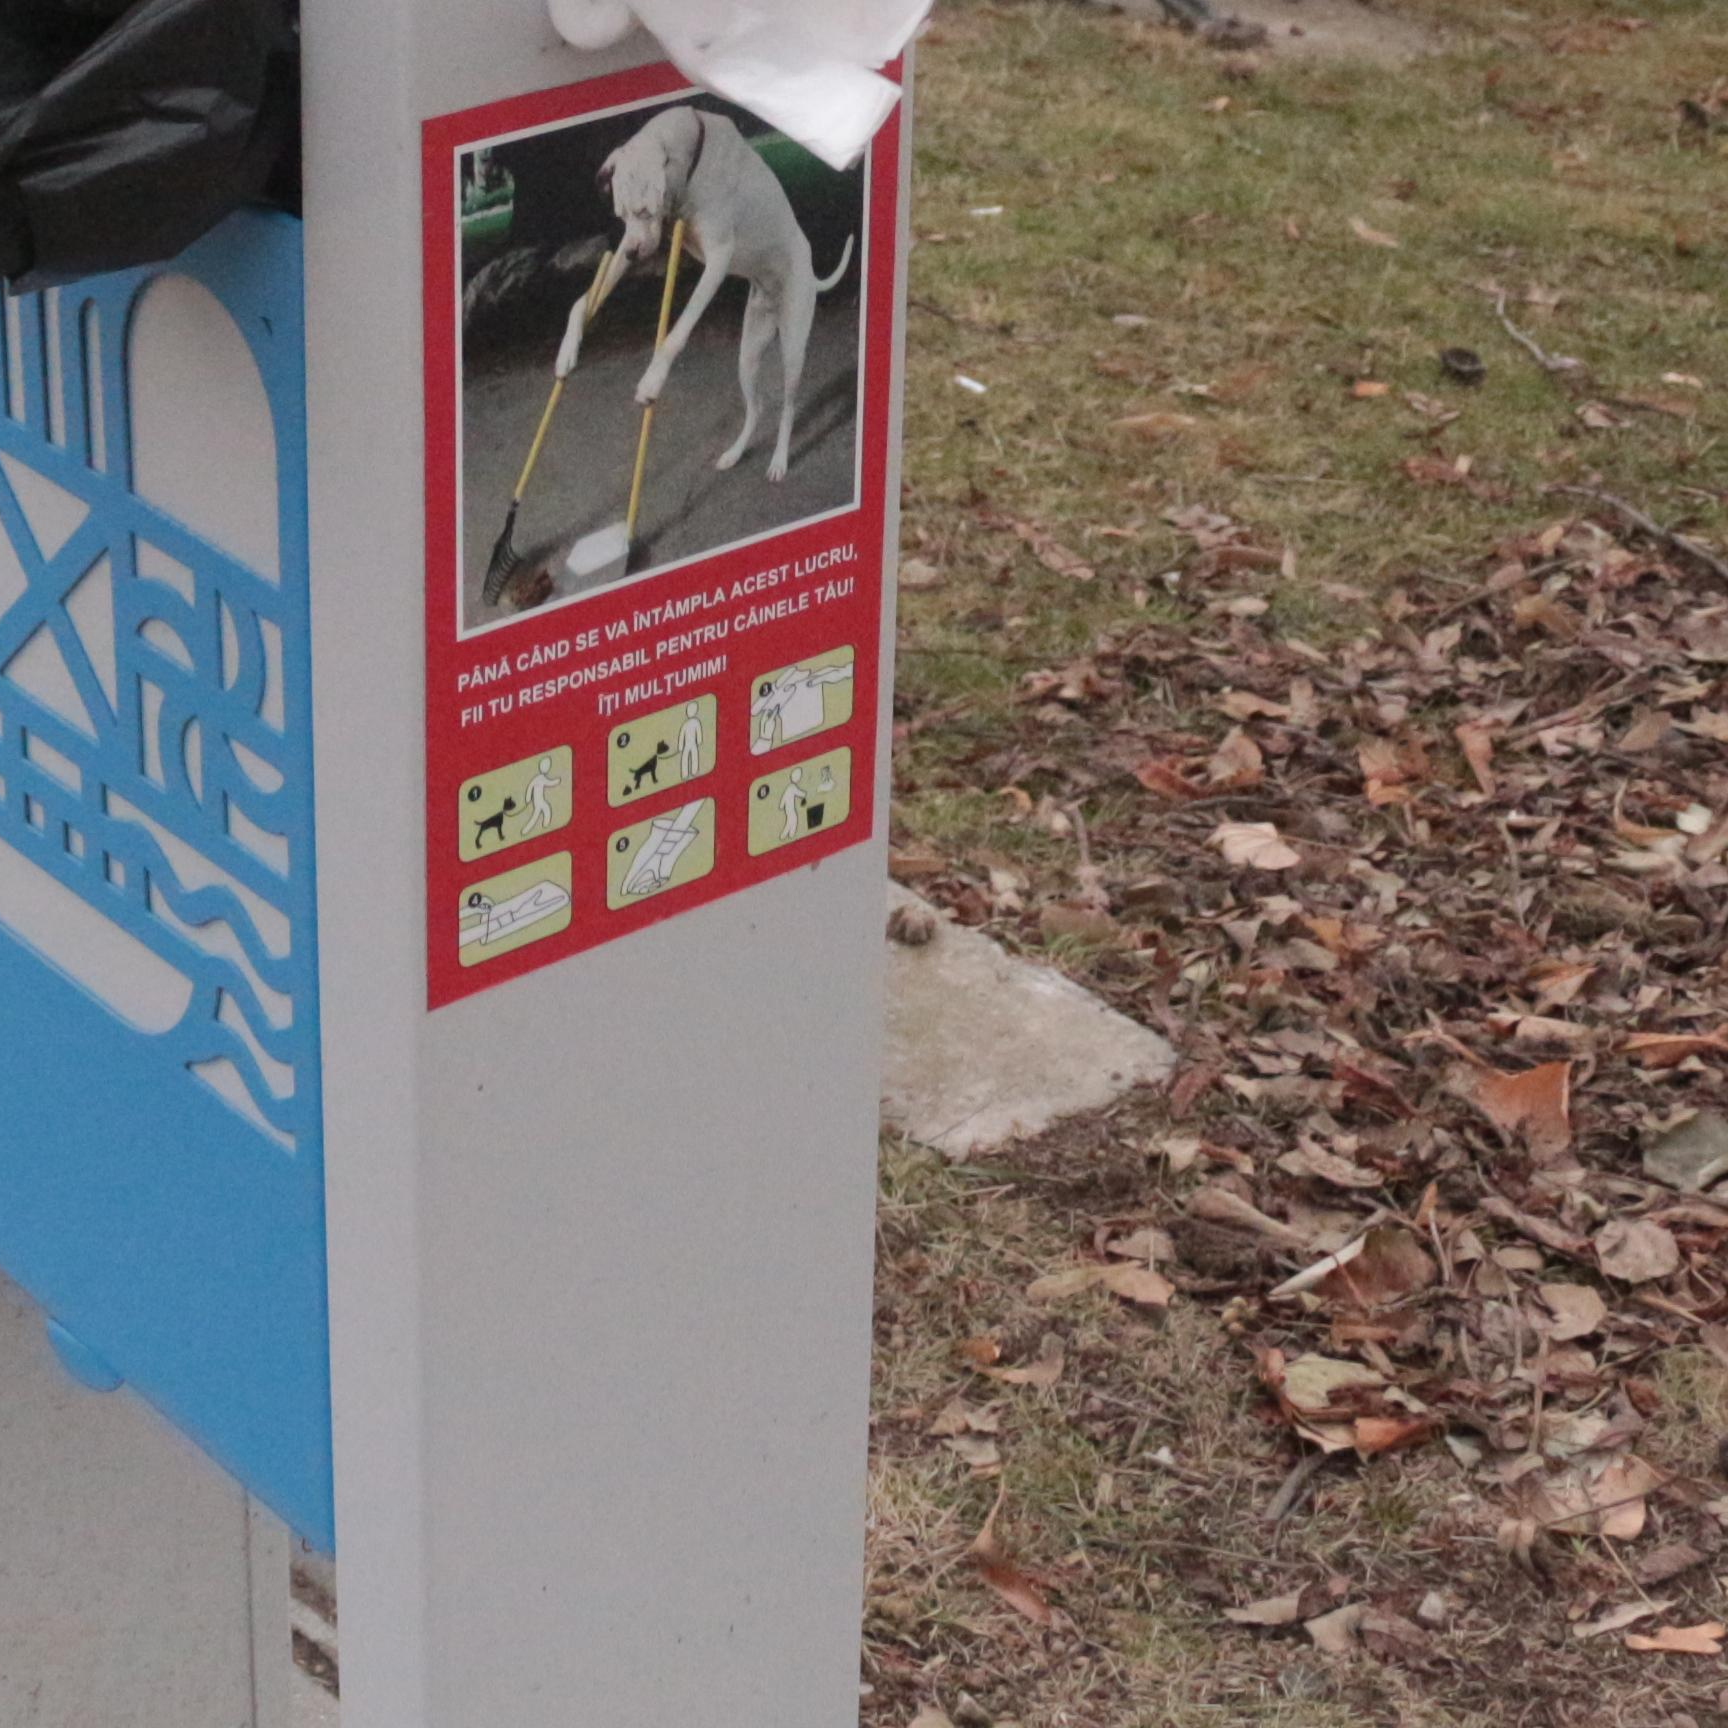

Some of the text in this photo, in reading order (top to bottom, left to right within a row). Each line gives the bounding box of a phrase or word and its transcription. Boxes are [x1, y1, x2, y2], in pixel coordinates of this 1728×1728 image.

[458, 543, 858, 692] PÂNĂ CÂND SE VA ÎNTÂMPLA ACEST LUCRU,
[461, 576, 854, 728] FII TU RESPONSABIL PENTRU CÂINELE TĂU!
